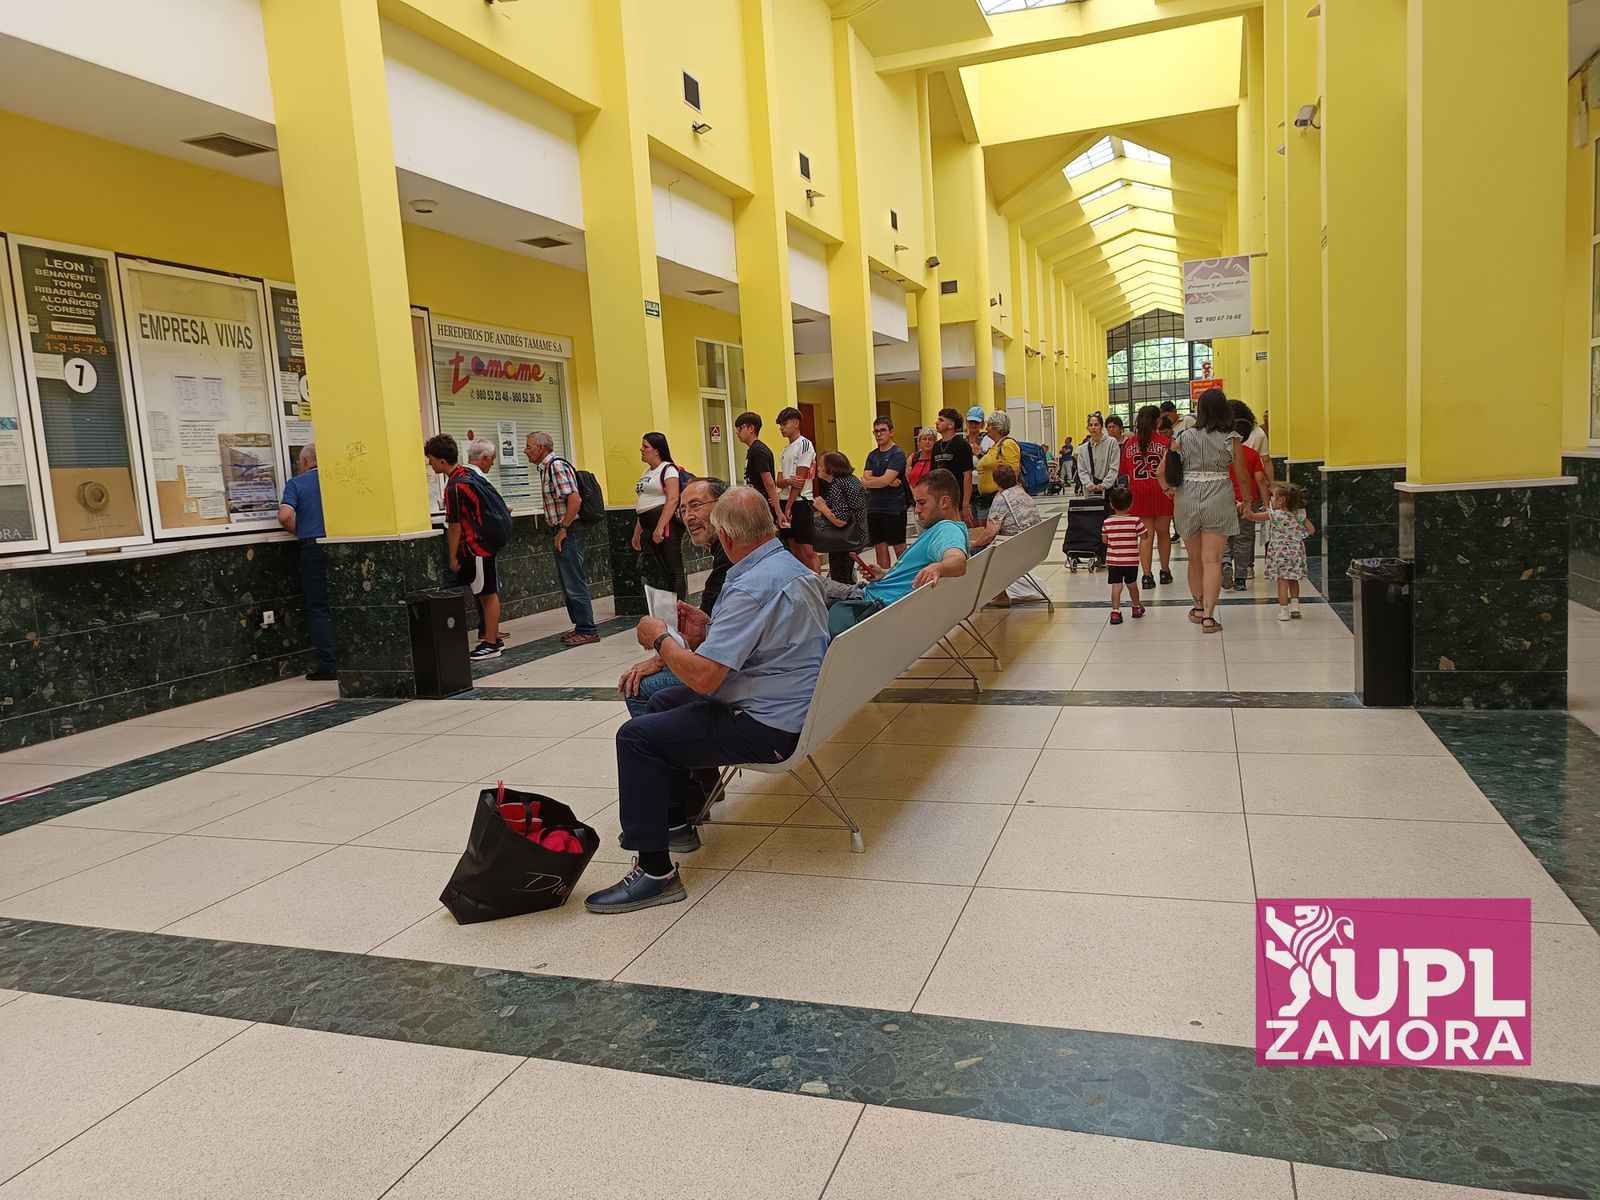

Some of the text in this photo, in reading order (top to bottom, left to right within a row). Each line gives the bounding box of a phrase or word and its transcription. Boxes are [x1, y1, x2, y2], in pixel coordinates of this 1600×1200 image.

[44, 258, 84, 272] LEON
[34, 268, 96, 283] BENAVENTE
[52, 279, 82, 290] TORO
[34, 285, 102, 300] RIBADELAGO
[40, 295, 99, 308] ALCAÑICES
[46, 304, 96, 316] CORESES
[138, 313, 253, 350] EMPRESA VIVAS
[436, 323, 482, 341] HEREDEROS
[484, 331, 494, 343] DE
[495, 333, 523, 348] ANDRÉS
[524, 337, 553, 352] TAMAME
[74, 364, 85, 386] 7
[448, 351, 546, 395] tamame
[476, 389, 486, 400] 980
[487, 390, 494, 400] 53
[494, 390, 502, 401] 20
[1133, 454, 1161, 480] 23
